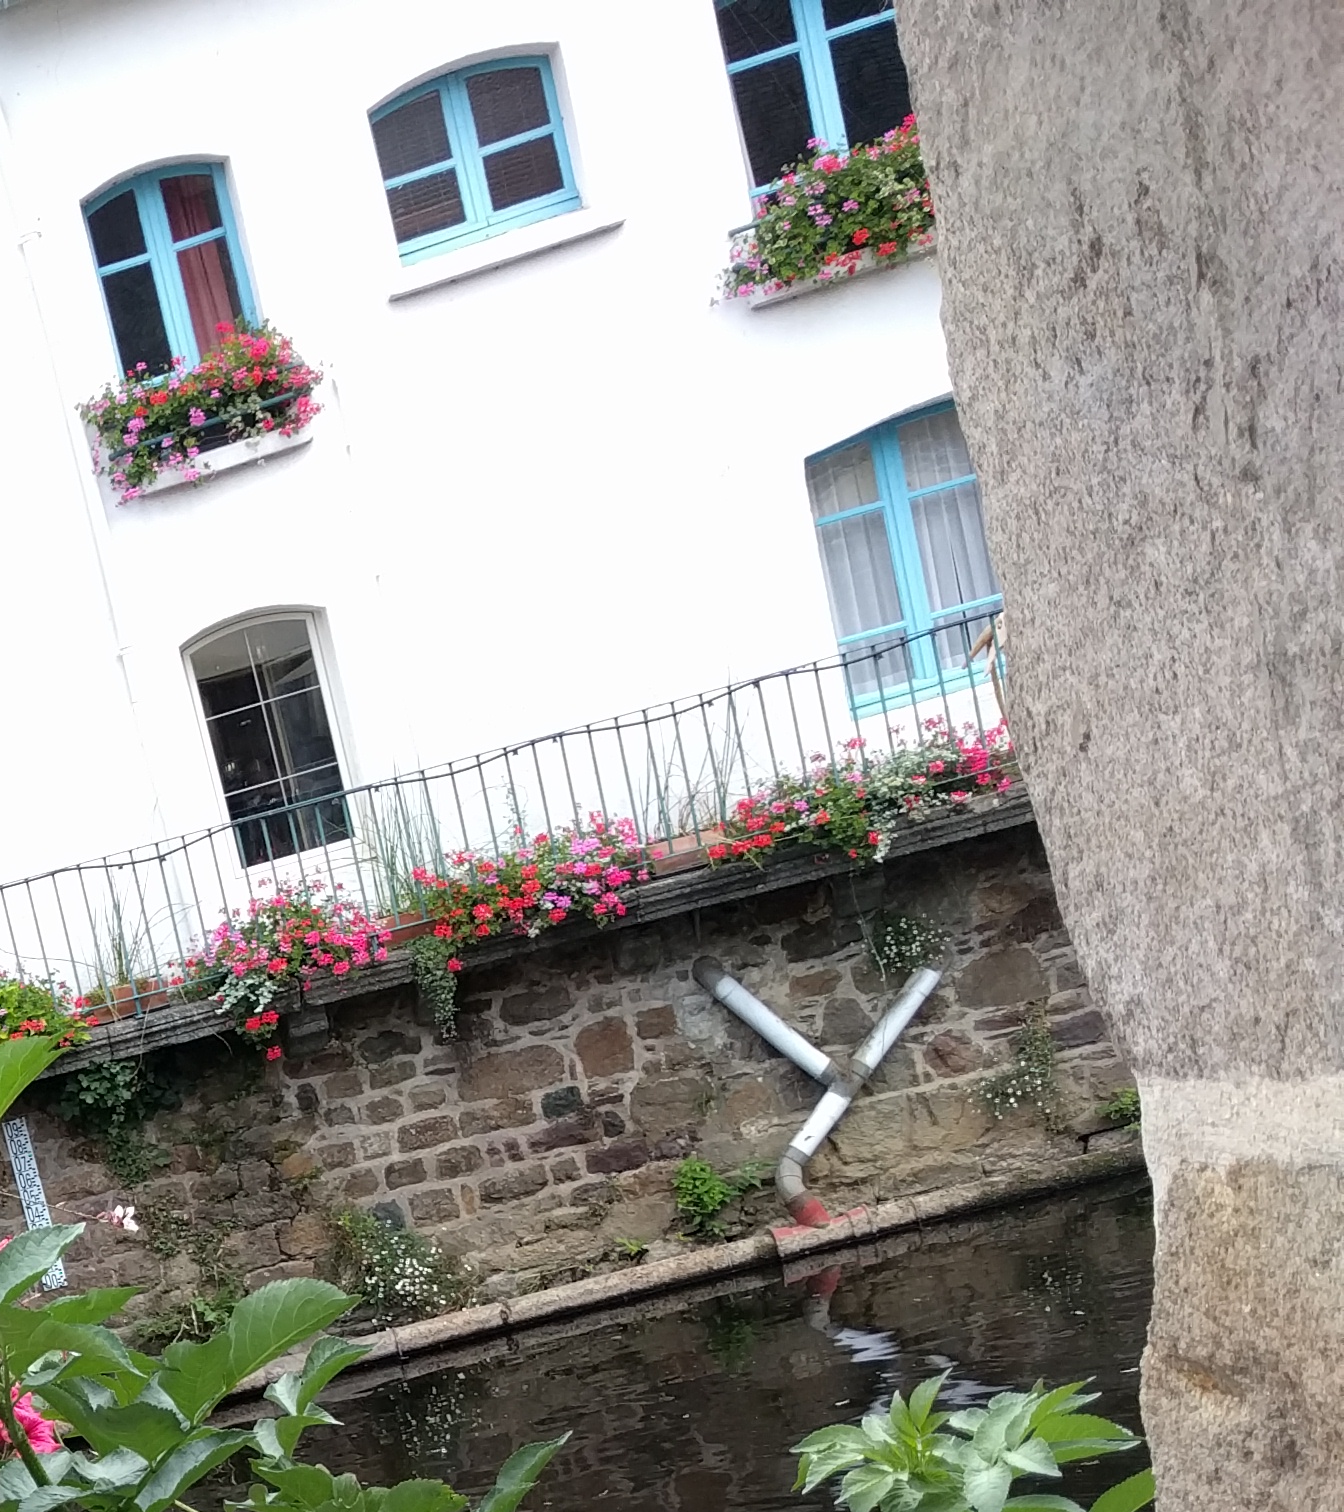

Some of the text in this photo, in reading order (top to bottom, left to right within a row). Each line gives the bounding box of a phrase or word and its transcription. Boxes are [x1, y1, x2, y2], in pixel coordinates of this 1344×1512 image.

[4, 1122, 20, 1139] 09
[9, 1139, 24, 1155] 08
[14, 1155, 27, 1172] 07
[18, 1172, 32, 1189] 06
[26, 1205, 41, 1223] 04
